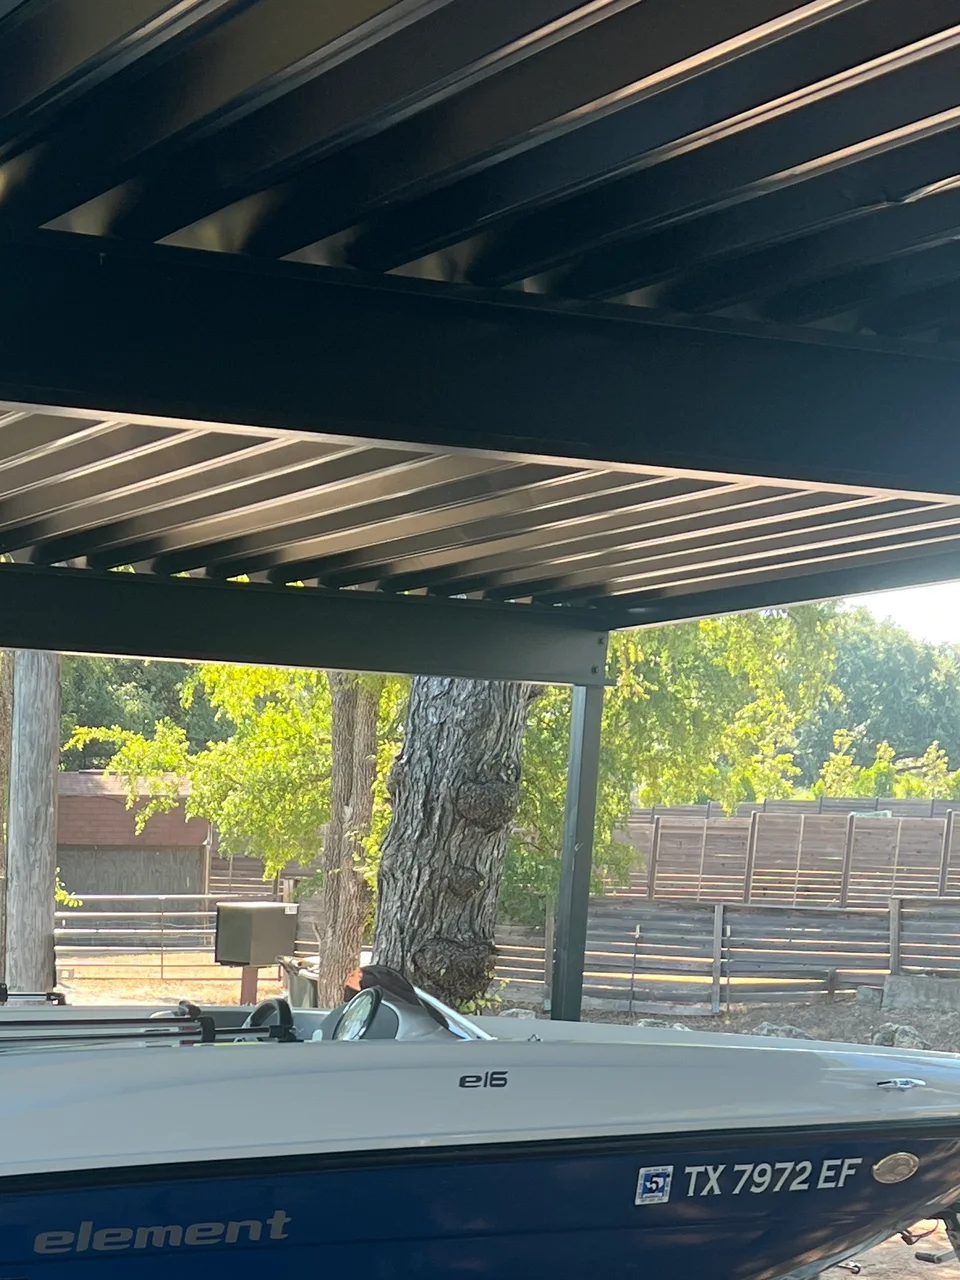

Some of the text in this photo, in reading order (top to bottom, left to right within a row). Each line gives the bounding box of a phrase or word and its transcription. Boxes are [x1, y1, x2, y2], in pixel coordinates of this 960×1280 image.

[684, 1157, 863, 1197] TX 7972 EF
[33, 1209, 292, 1255] element
